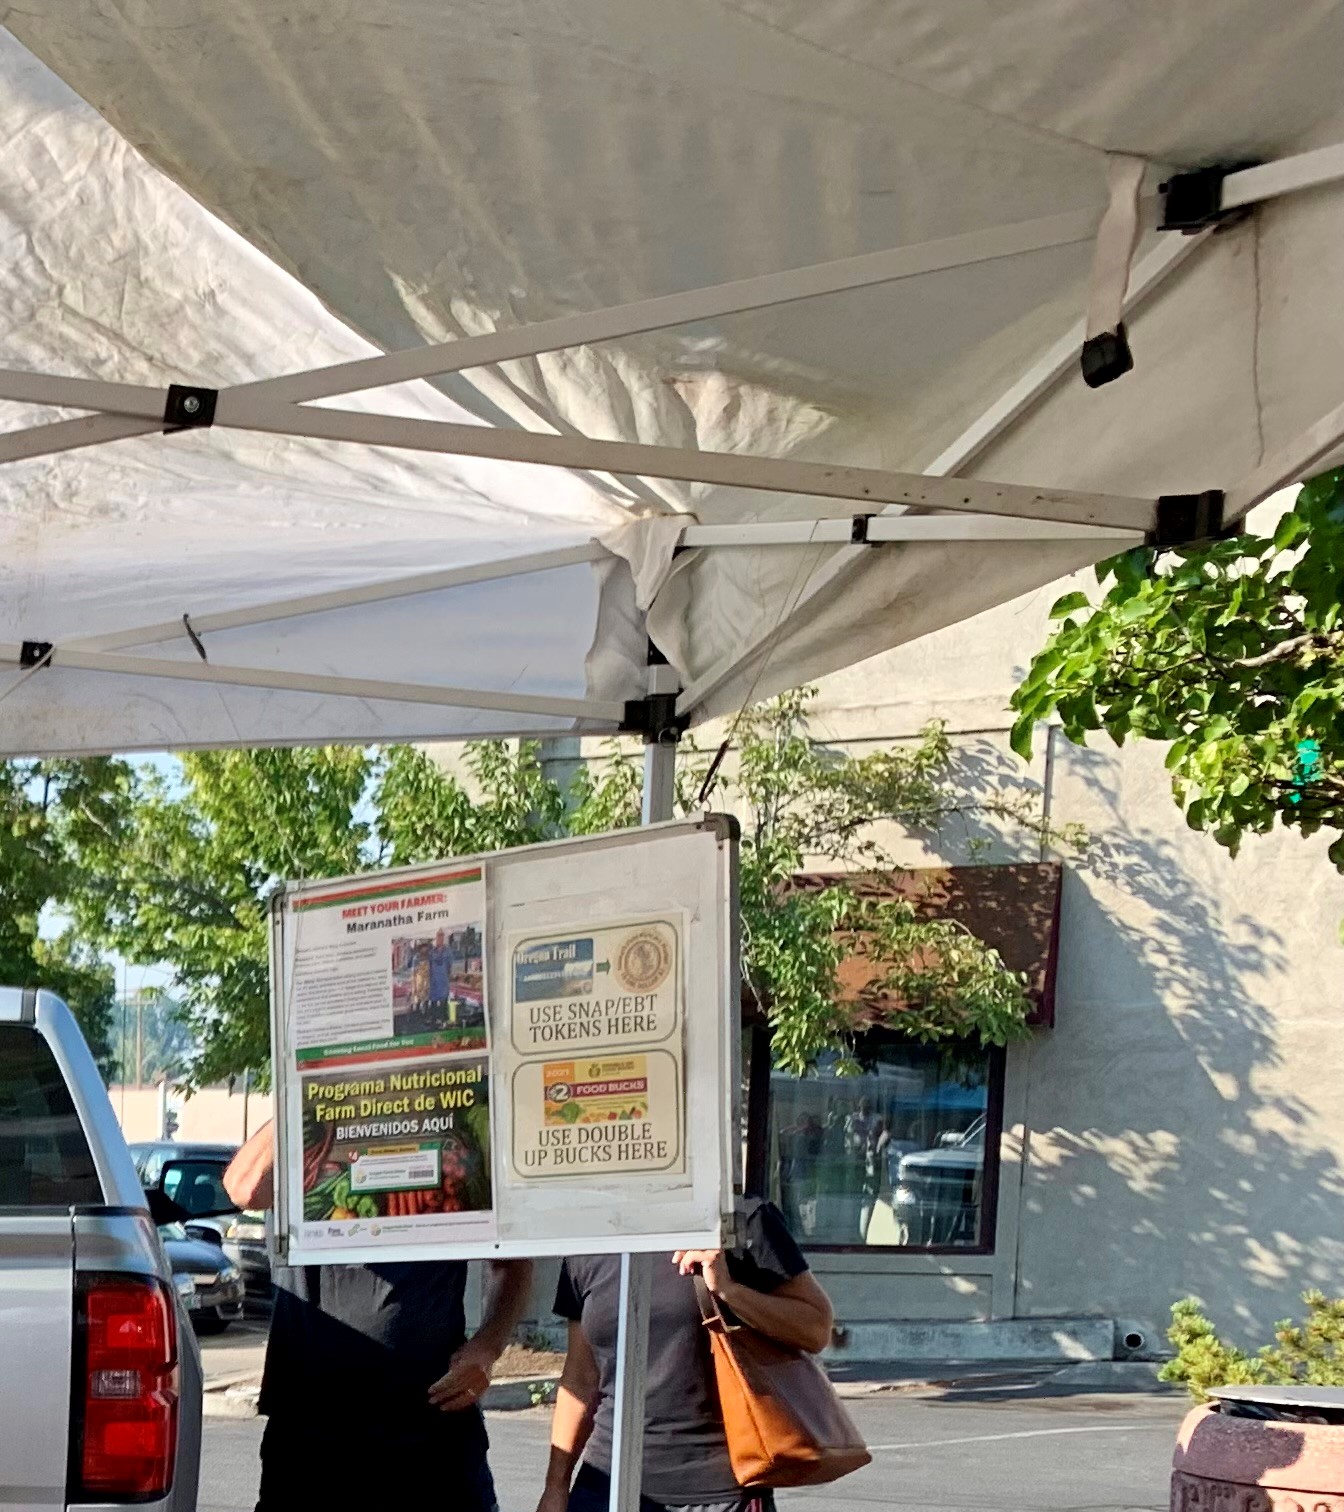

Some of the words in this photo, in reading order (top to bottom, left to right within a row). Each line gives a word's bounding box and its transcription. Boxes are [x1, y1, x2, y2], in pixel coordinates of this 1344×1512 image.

[342, 903, 369, 919] MEET
[370, 899, 399, 915] YOUR
[400, 893, 447, 910] FARMER:
[346, 915, 413, 934] Maranatha
[417, 908, 449, 922] Farm
[553, 944, 577, 960] Trail
[529, 1004, 563, 1025] USE
[568, 993, 658, 1021] SNAP/EBT
[529, 1019, 602, 1043] TOKENS
[607, 1013, 657, 1035] HERE
[308, 1079, 384, 1101] Programa
[390, 1065, 482, 1091] Nutricional
[576, 1083, 608, 1095] FOOD
[609, 1080, 645, 1092] BUCKS
[316, 1103, 355, 1122] Farm
[360, 1097, 410, 1118] Direct
[414, 1093, 435, 1110] de
[440, 1089, 475, 1109] WIC
[336, 1119, 419, 1140] BIENVENIDOS
[422, 1112, 454, 1134] AQUÍ
[539, 1129, 572, 1147] USE
[578, 1123, 652, 1145] DOUBLE
[524, 1149, 548, 1167] UP
[553, 1145, 613, 1165] BUCKS
[618, 1141, 668, 1161] HERE
